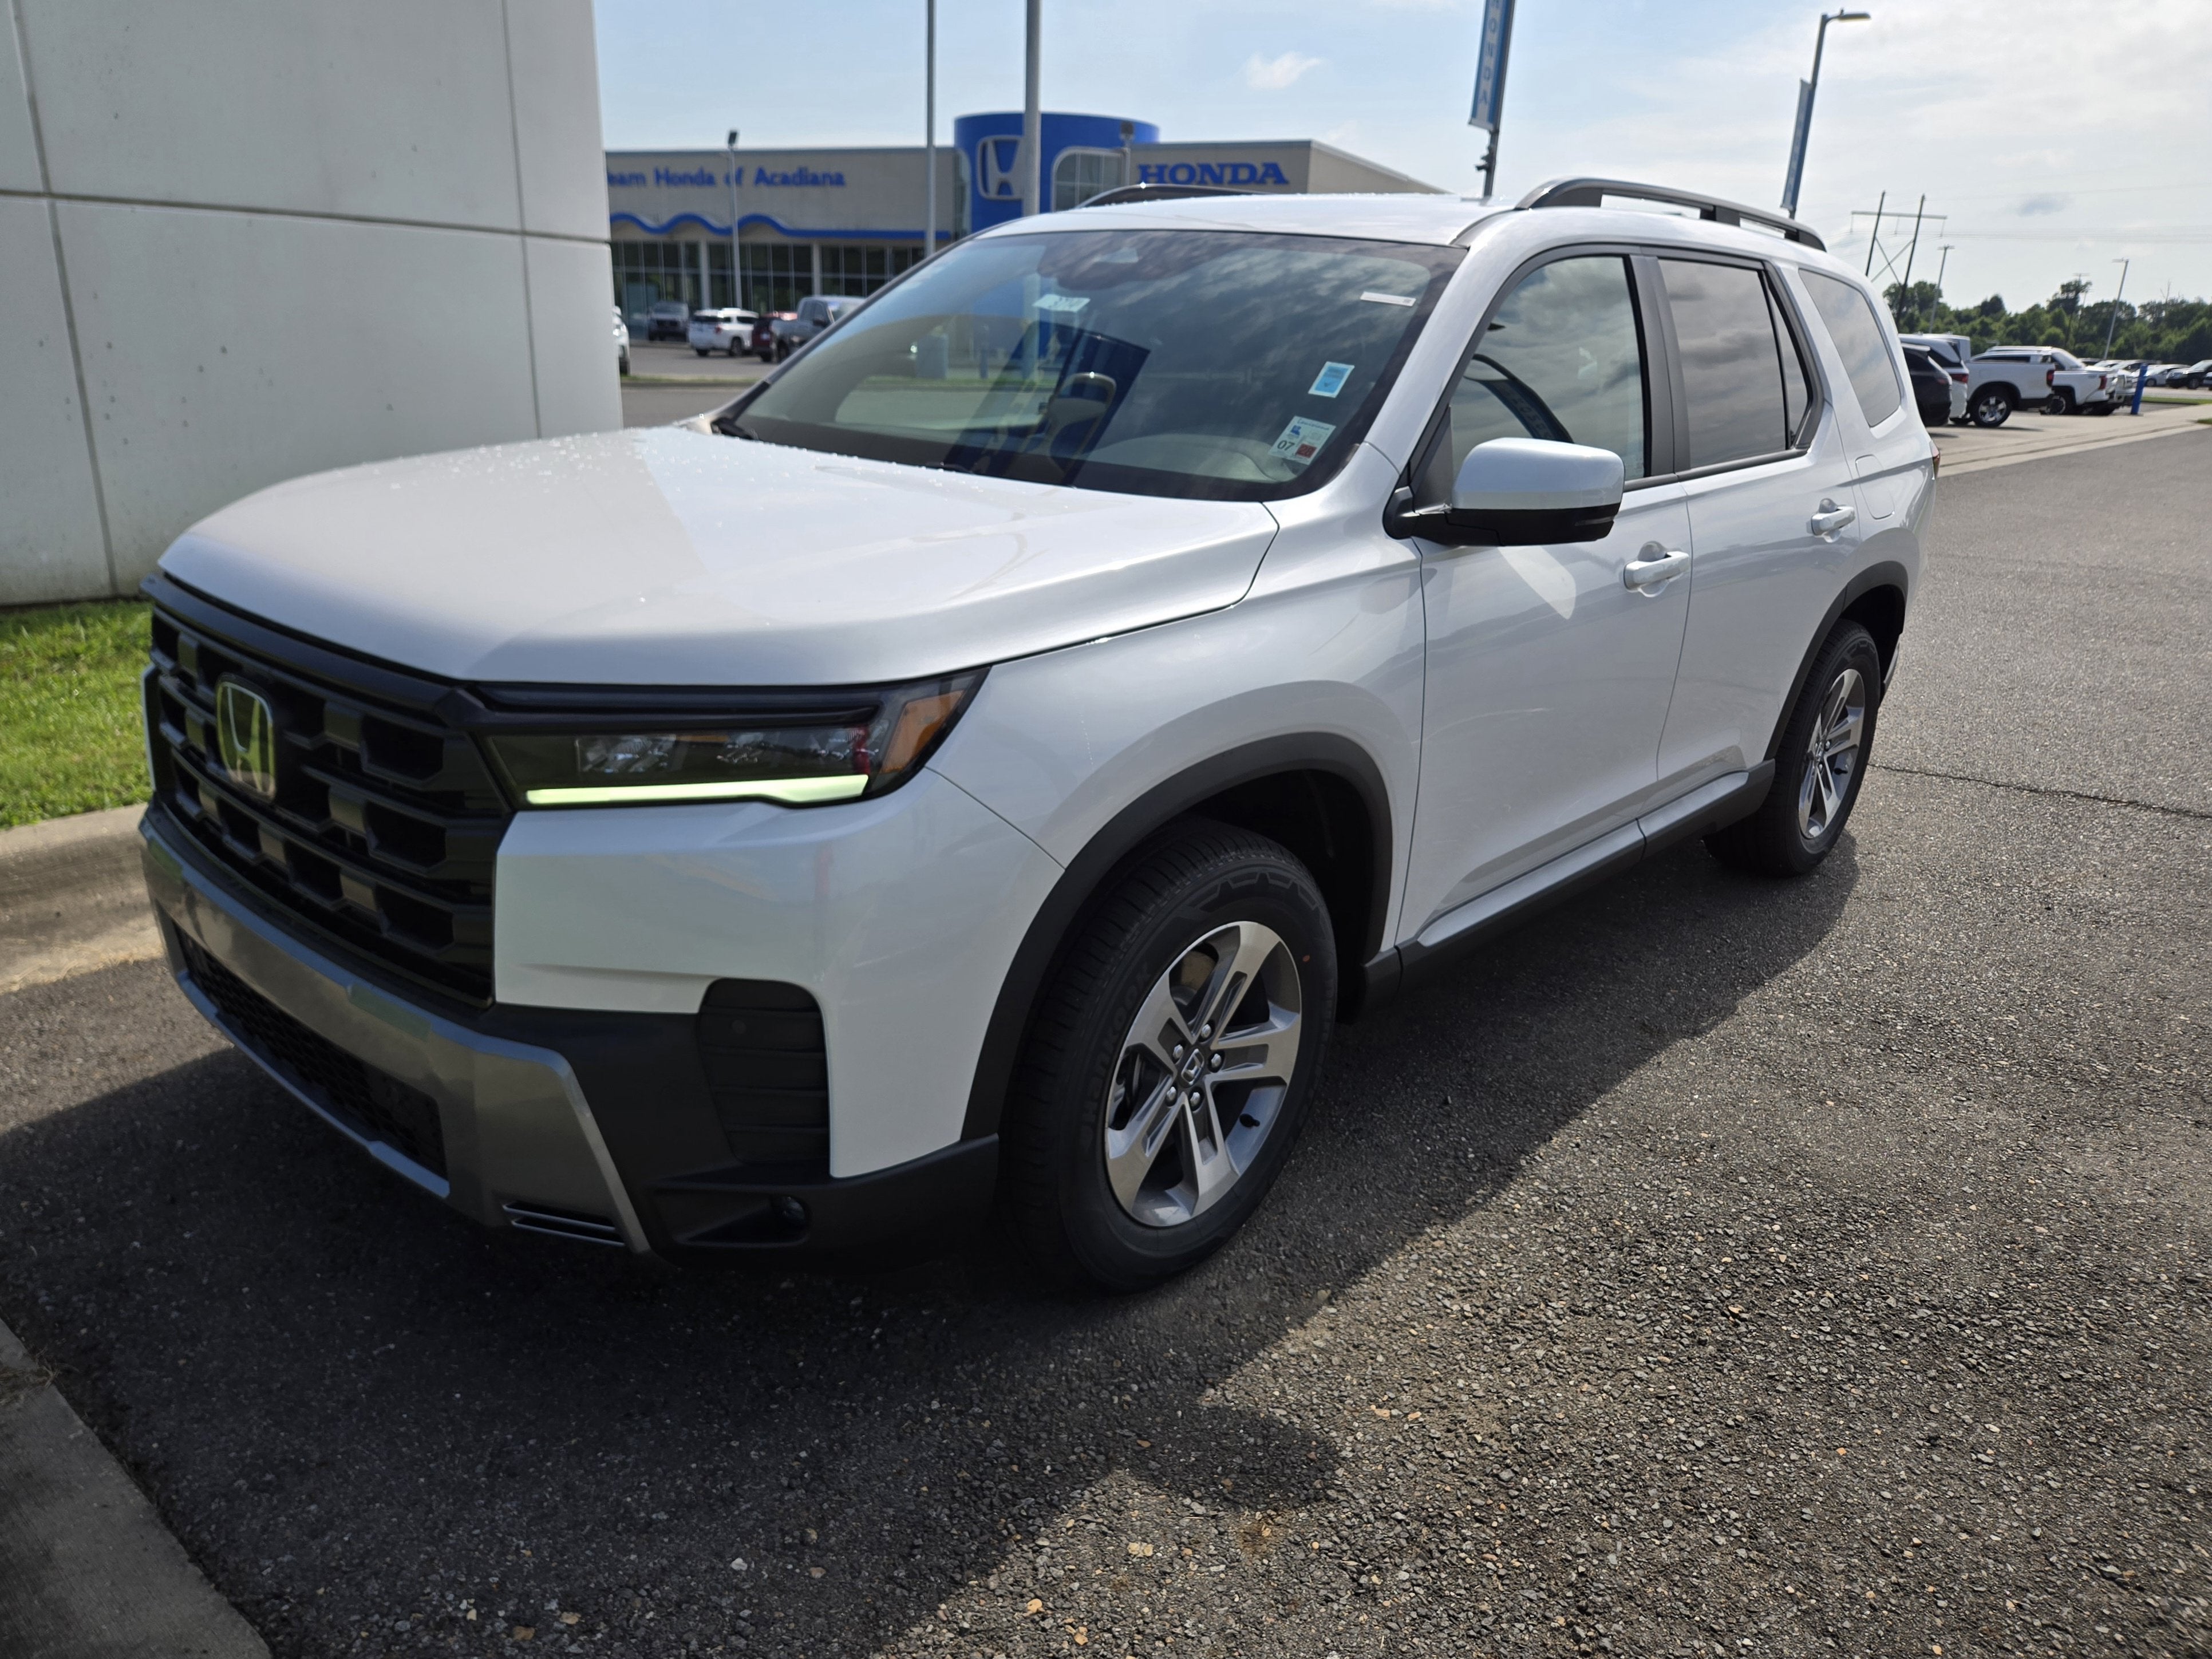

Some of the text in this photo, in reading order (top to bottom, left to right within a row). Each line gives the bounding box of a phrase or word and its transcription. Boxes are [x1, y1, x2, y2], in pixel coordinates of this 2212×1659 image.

[654, 165, 715, 187] Honda
[754, 165, 846, 187] Acadiana
[1137, 162, 1289, 185] HONDA
[1277, 440, 1295, 451] 07
